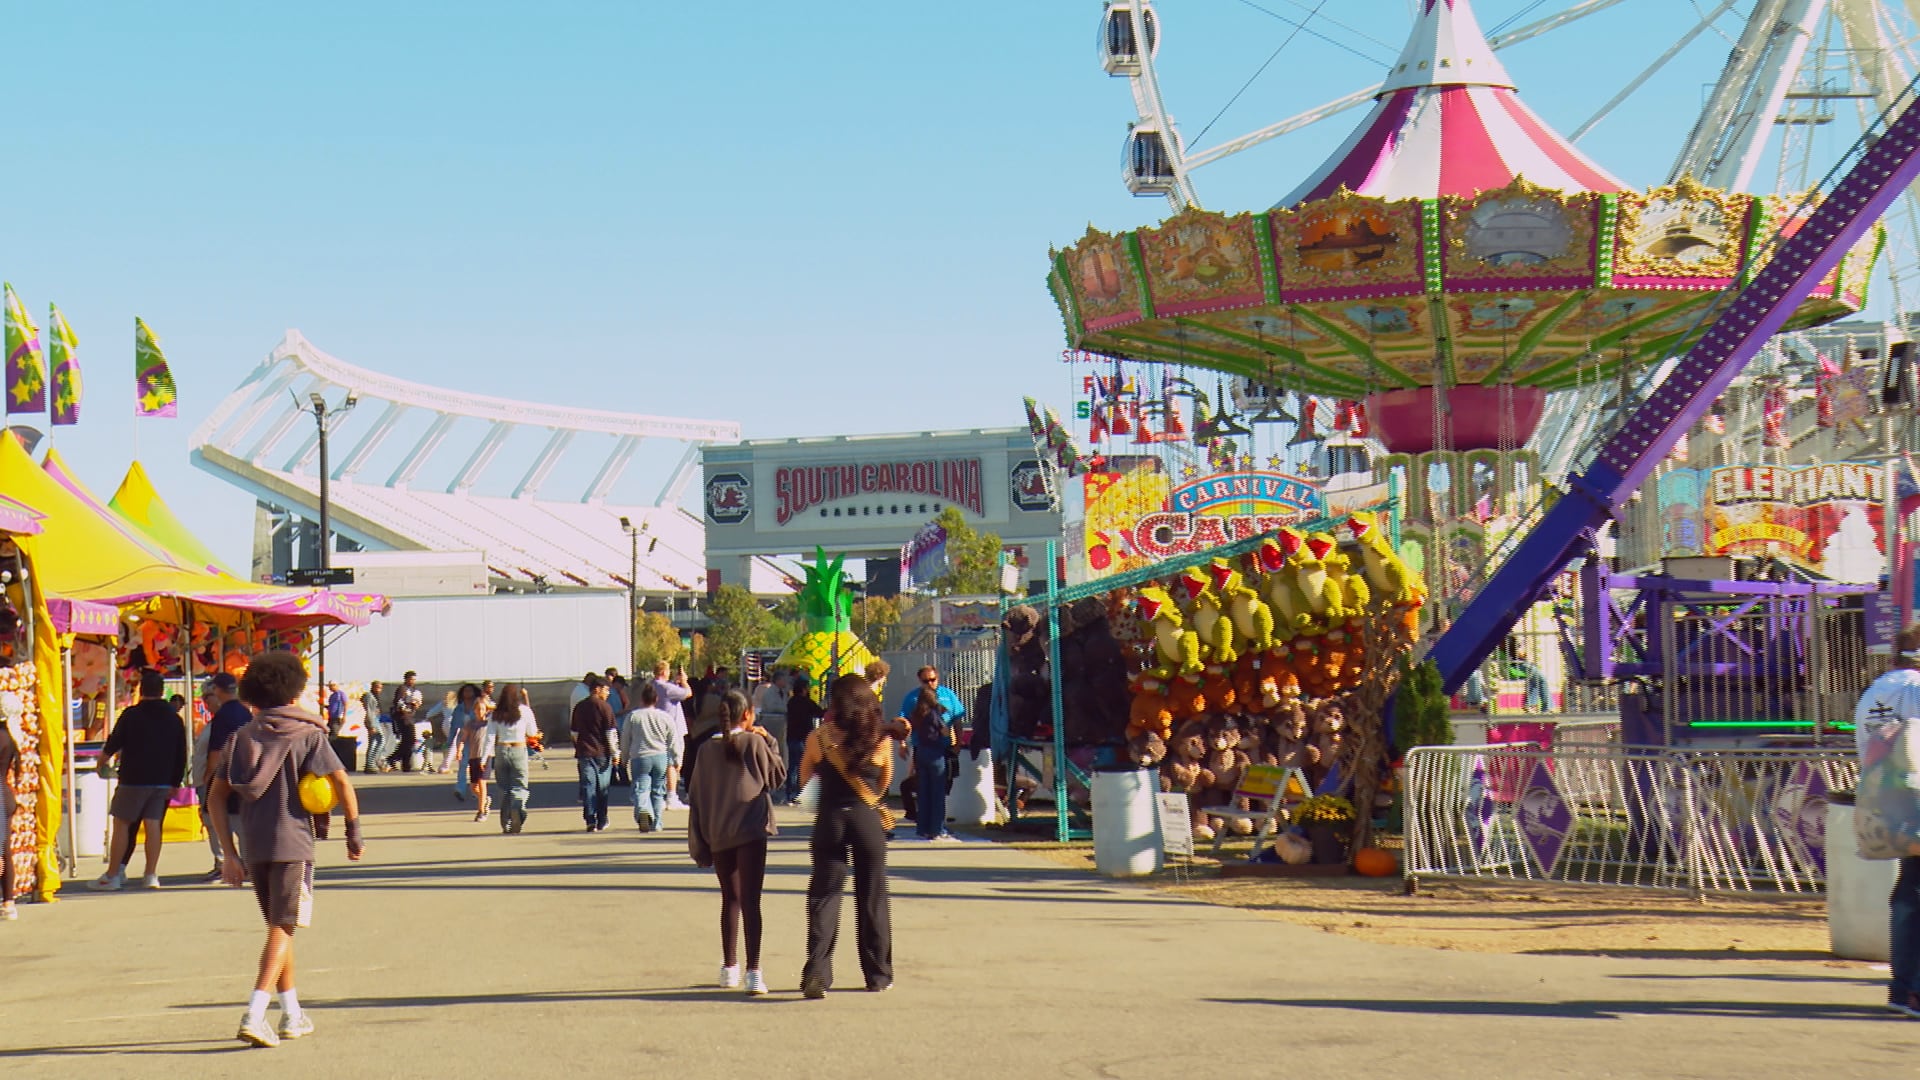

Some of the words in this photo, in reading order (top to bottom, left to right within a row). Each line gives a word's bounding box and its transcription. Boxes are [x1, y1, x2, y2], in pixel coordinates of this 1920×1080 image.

[775, 464, 857, 525] SOUTH
[861, 457, 984, 518] CAROLINA
[1178, 478, 1313, 509] CARNIVAL
[1714, 465, 1884, 504] ELEPHANT
[820, 503, 941, 517] GAMECOCKS
